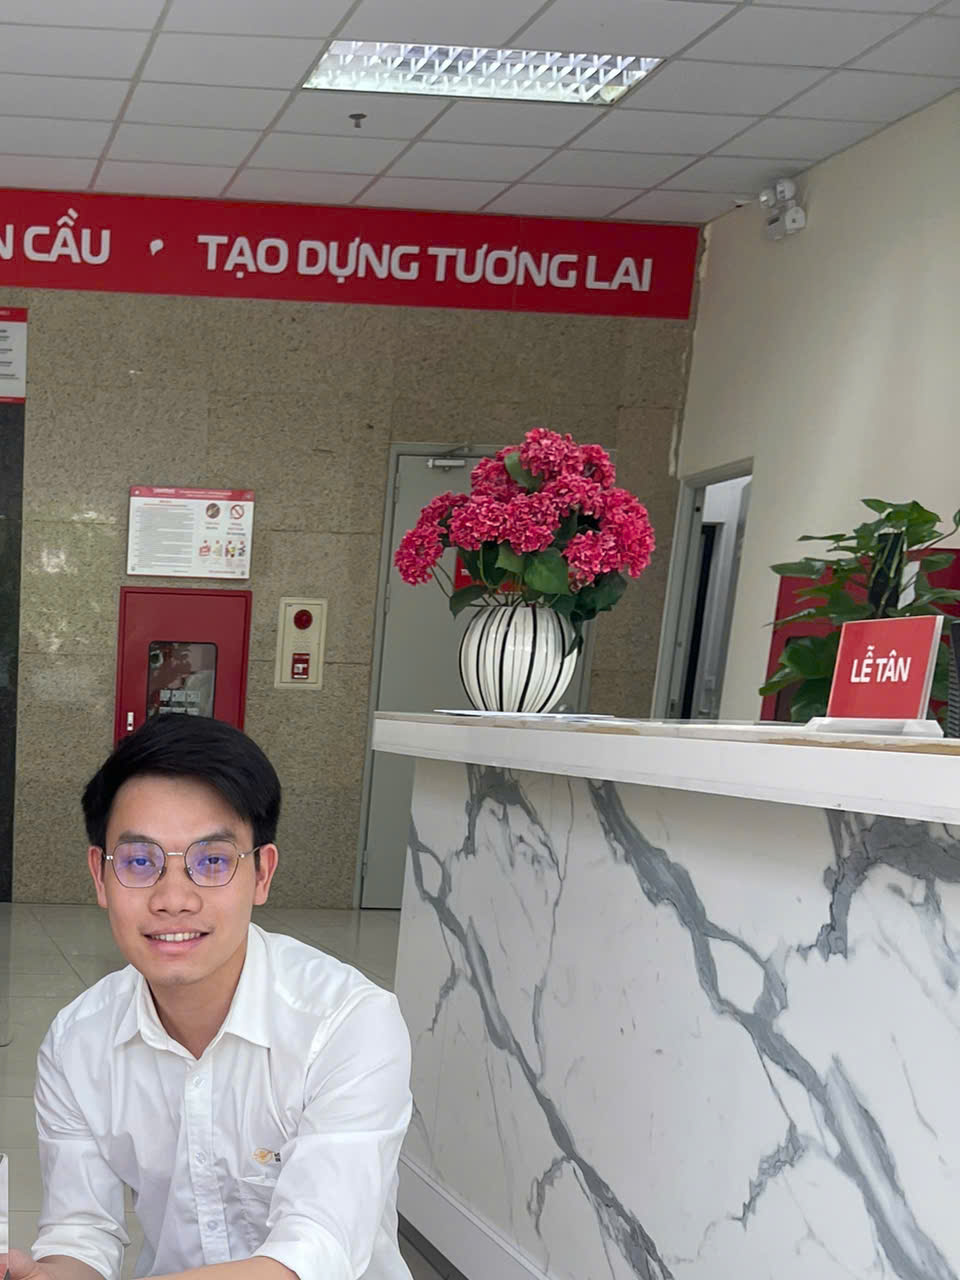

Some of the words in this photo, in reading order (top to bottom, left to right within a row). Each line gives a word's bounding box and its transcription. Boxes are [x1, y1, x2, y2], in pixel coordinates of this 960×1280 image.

[24, 208, 110, 264] CẦU
[198, 235, 288, 278] TẠO
[298, 238, 419, 283] DỰNG
[428, 244, 577, 287] TƯƠNG
[586, 256, 652, 291] LAI
[851, 646, 874, 682] LỄ
[876, 650, 911, 682] TÂN
